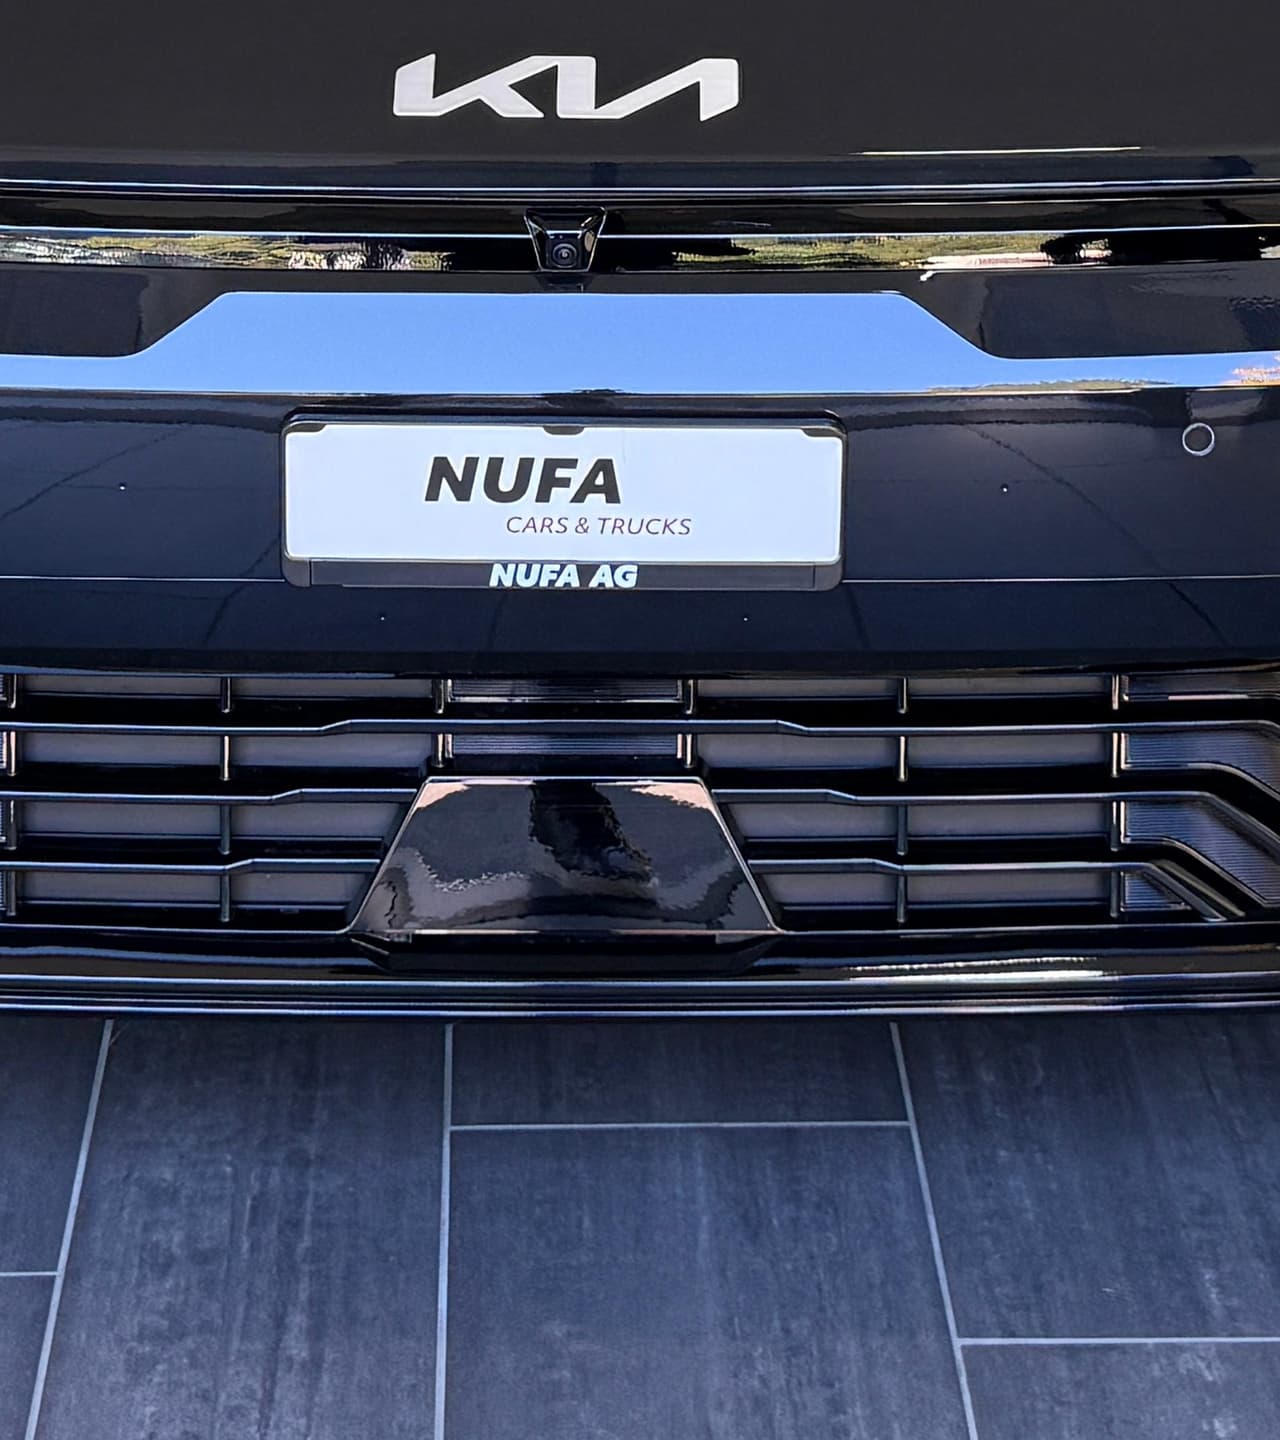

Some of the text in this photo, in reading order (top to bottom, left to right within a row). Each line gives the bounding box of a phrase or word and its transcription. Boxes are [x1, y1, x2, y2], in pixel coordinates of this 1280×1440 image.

[392, 53, 740, 122] KIA
[424, 456, 622, 505] NUFA
[505, 516, 692, 536] CARS & TRUCKS
[488, 562, 639, 590] NUFA AG
